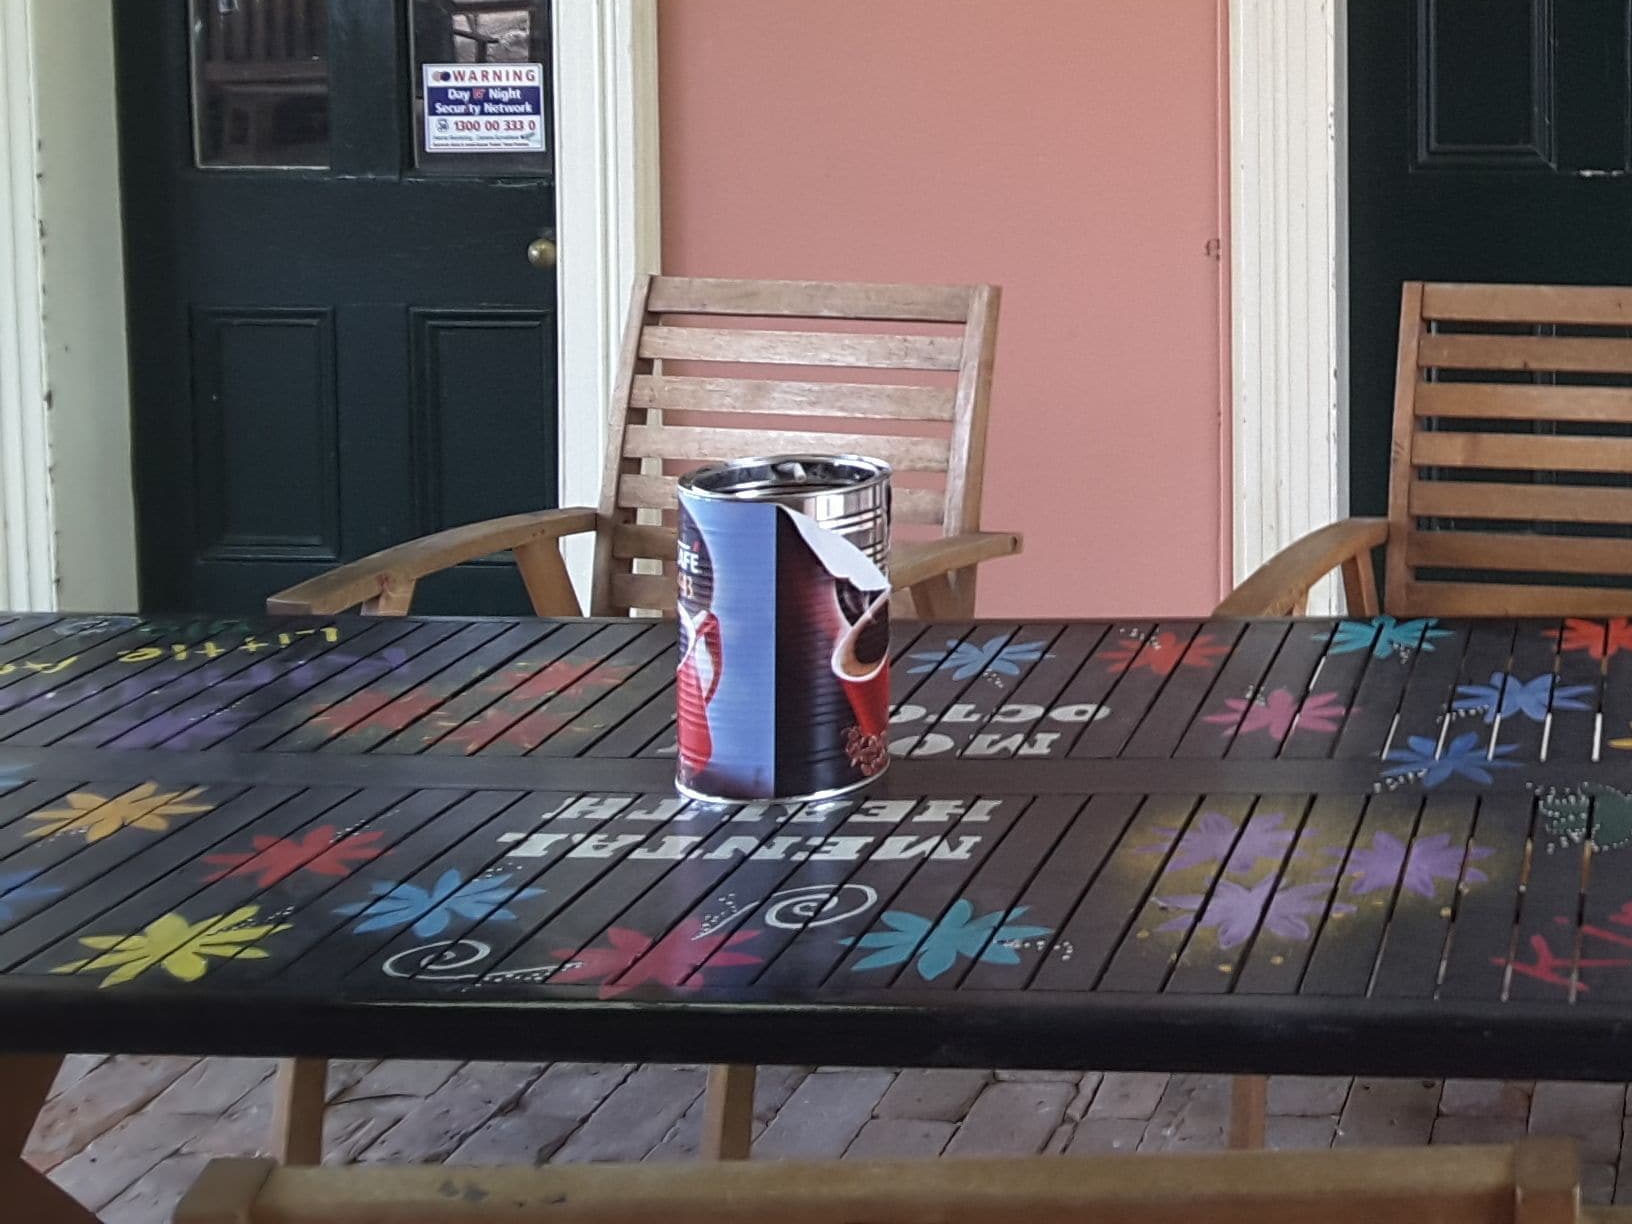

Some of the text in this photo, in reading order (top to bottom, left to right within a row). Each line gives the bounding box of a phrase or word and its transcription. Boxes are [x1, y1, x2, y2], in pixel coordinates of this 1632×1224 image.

[452, 69, 535, 82] WARNING
[447, 87, 471, 102] Day
[488, 87, 522, 102] Night
[483, 101, 533, 114] Network
[453, 119, 536, 131] 1300 00 333 0
[116, 626, 338, 663] Little
[541, 797, 1003, 822] HEALTH
[496, 832, 982, 861] MENTAL
